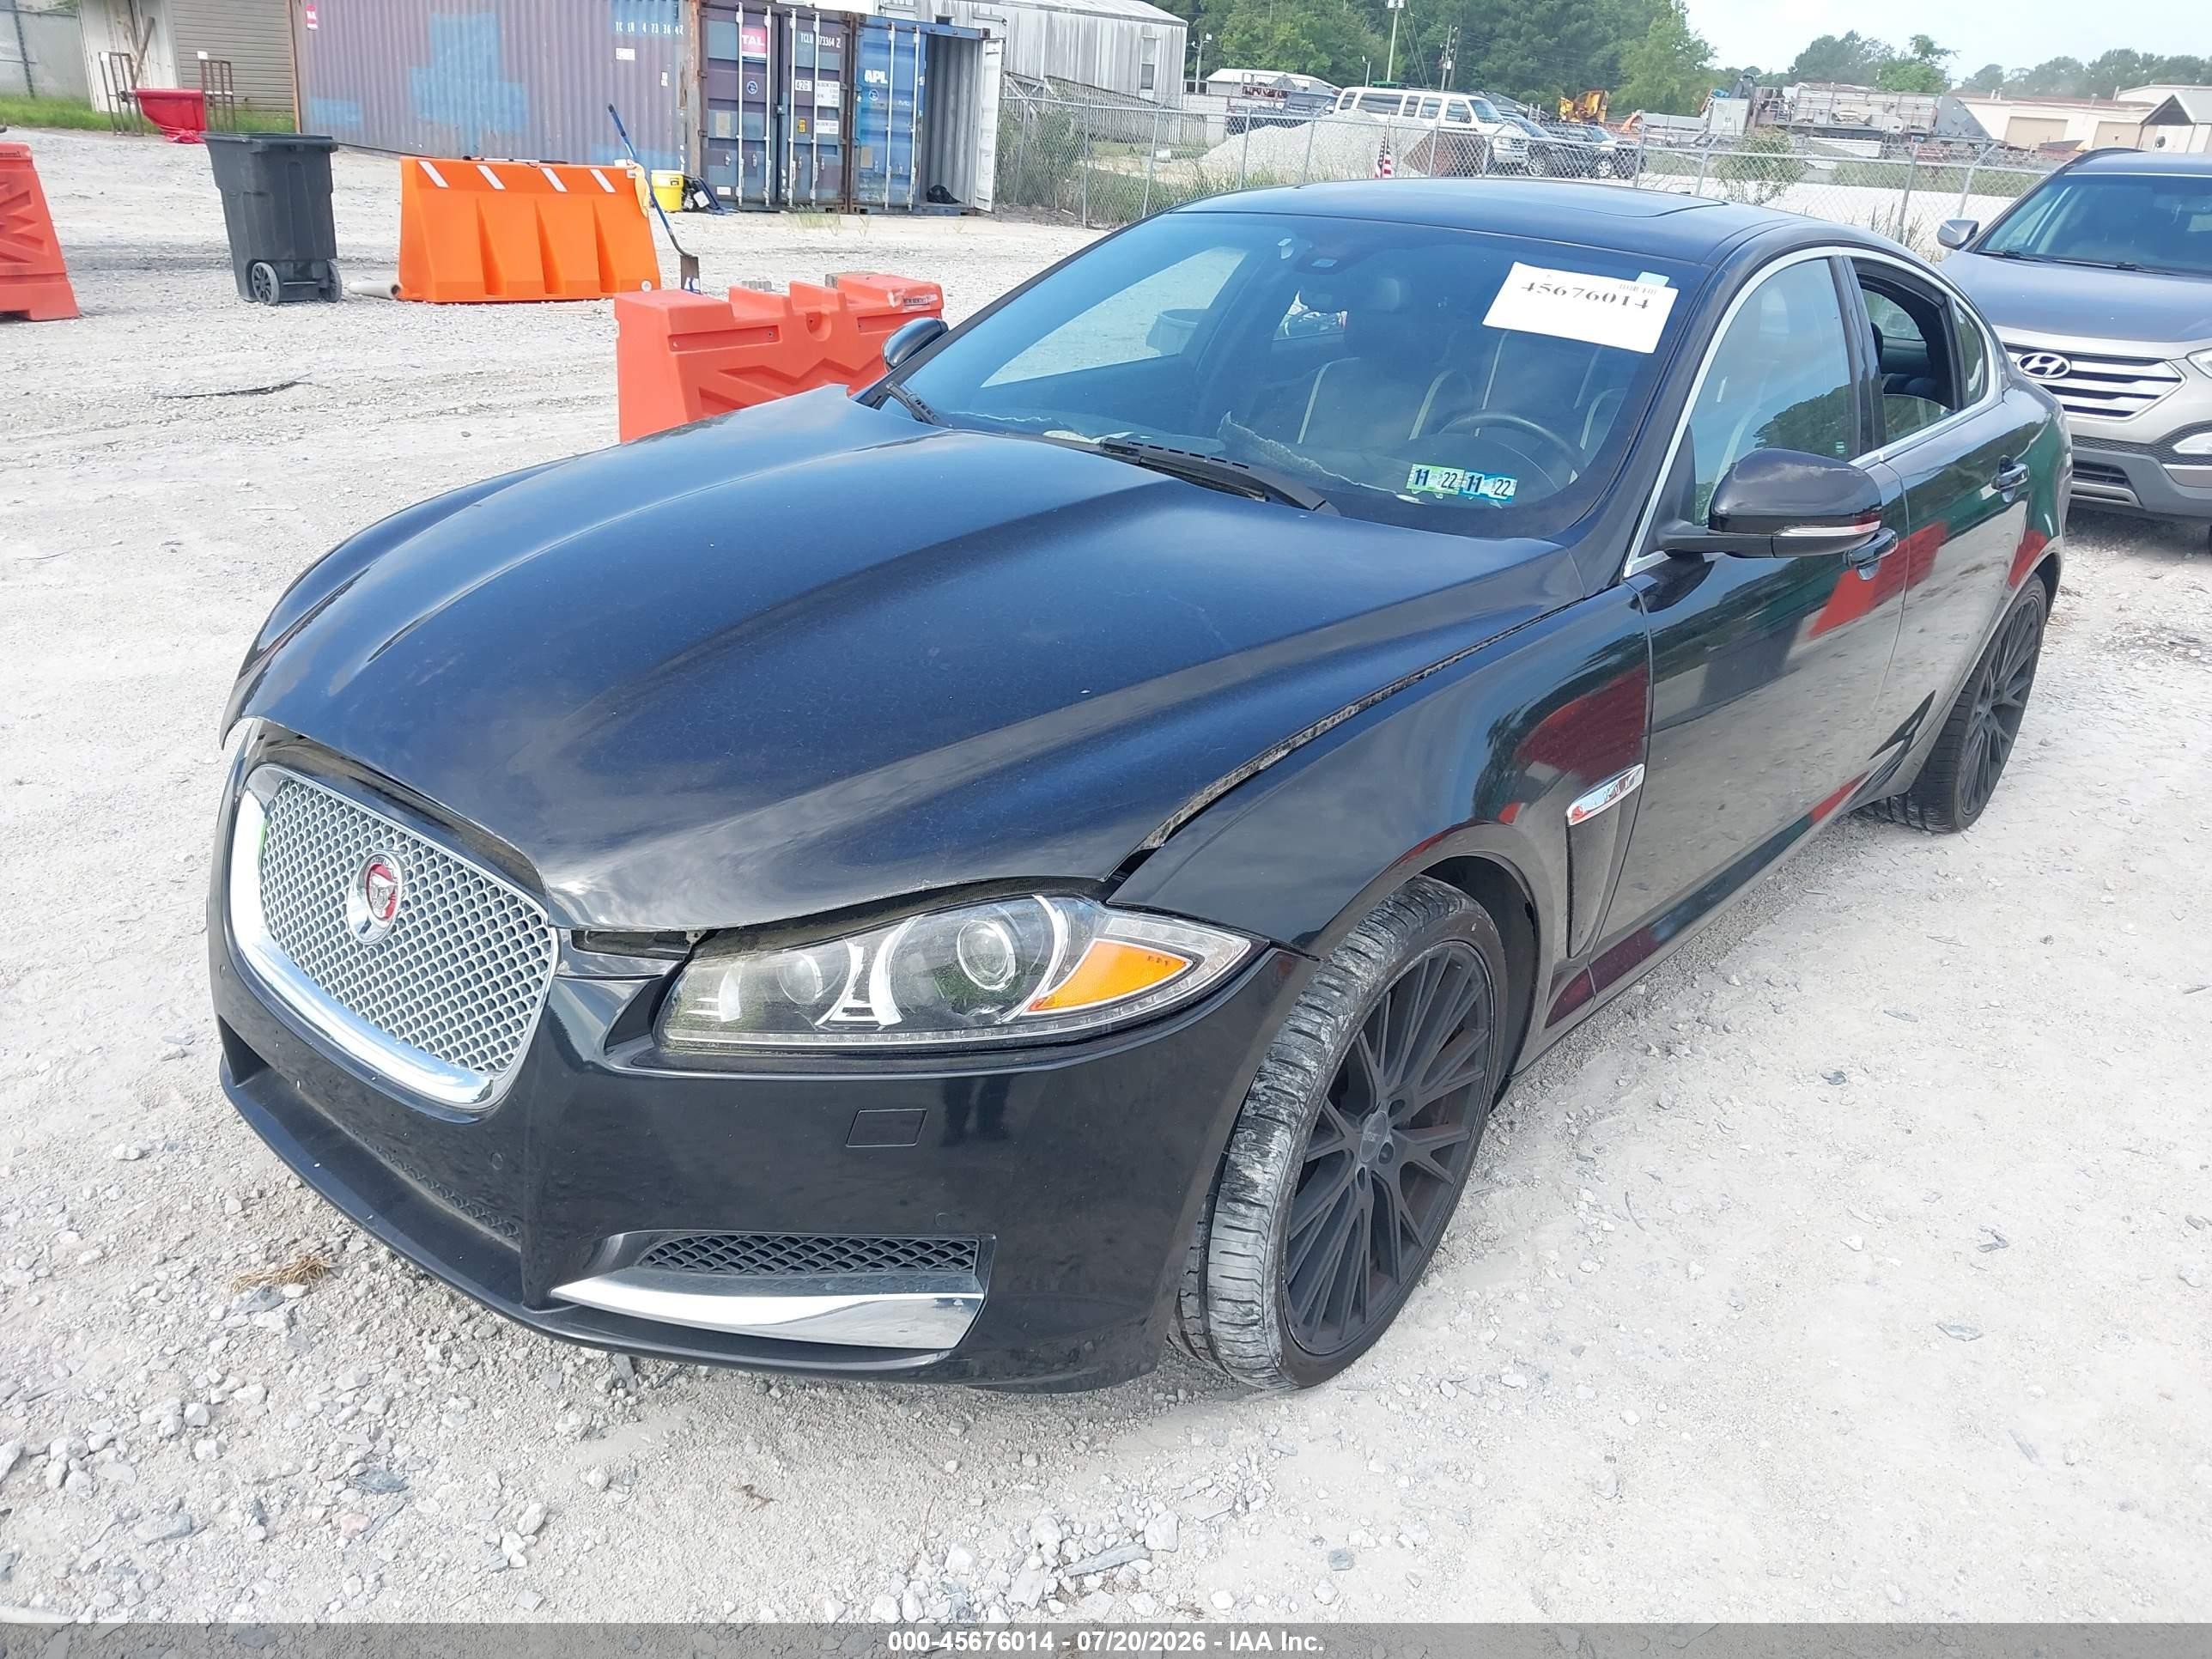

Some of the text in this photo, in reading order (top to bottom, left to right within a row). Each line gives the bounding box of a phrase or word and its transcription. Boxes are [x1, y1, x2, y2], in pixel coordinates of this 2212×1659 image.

[742, 34, 765, 46] TAL
[864, 69, 889, 84] APL
[1521, 282, 1650, 309] 45676014
[1415, 469, 1458, 489] 11 22
[1468, 475, 1511, 496] 11 22
